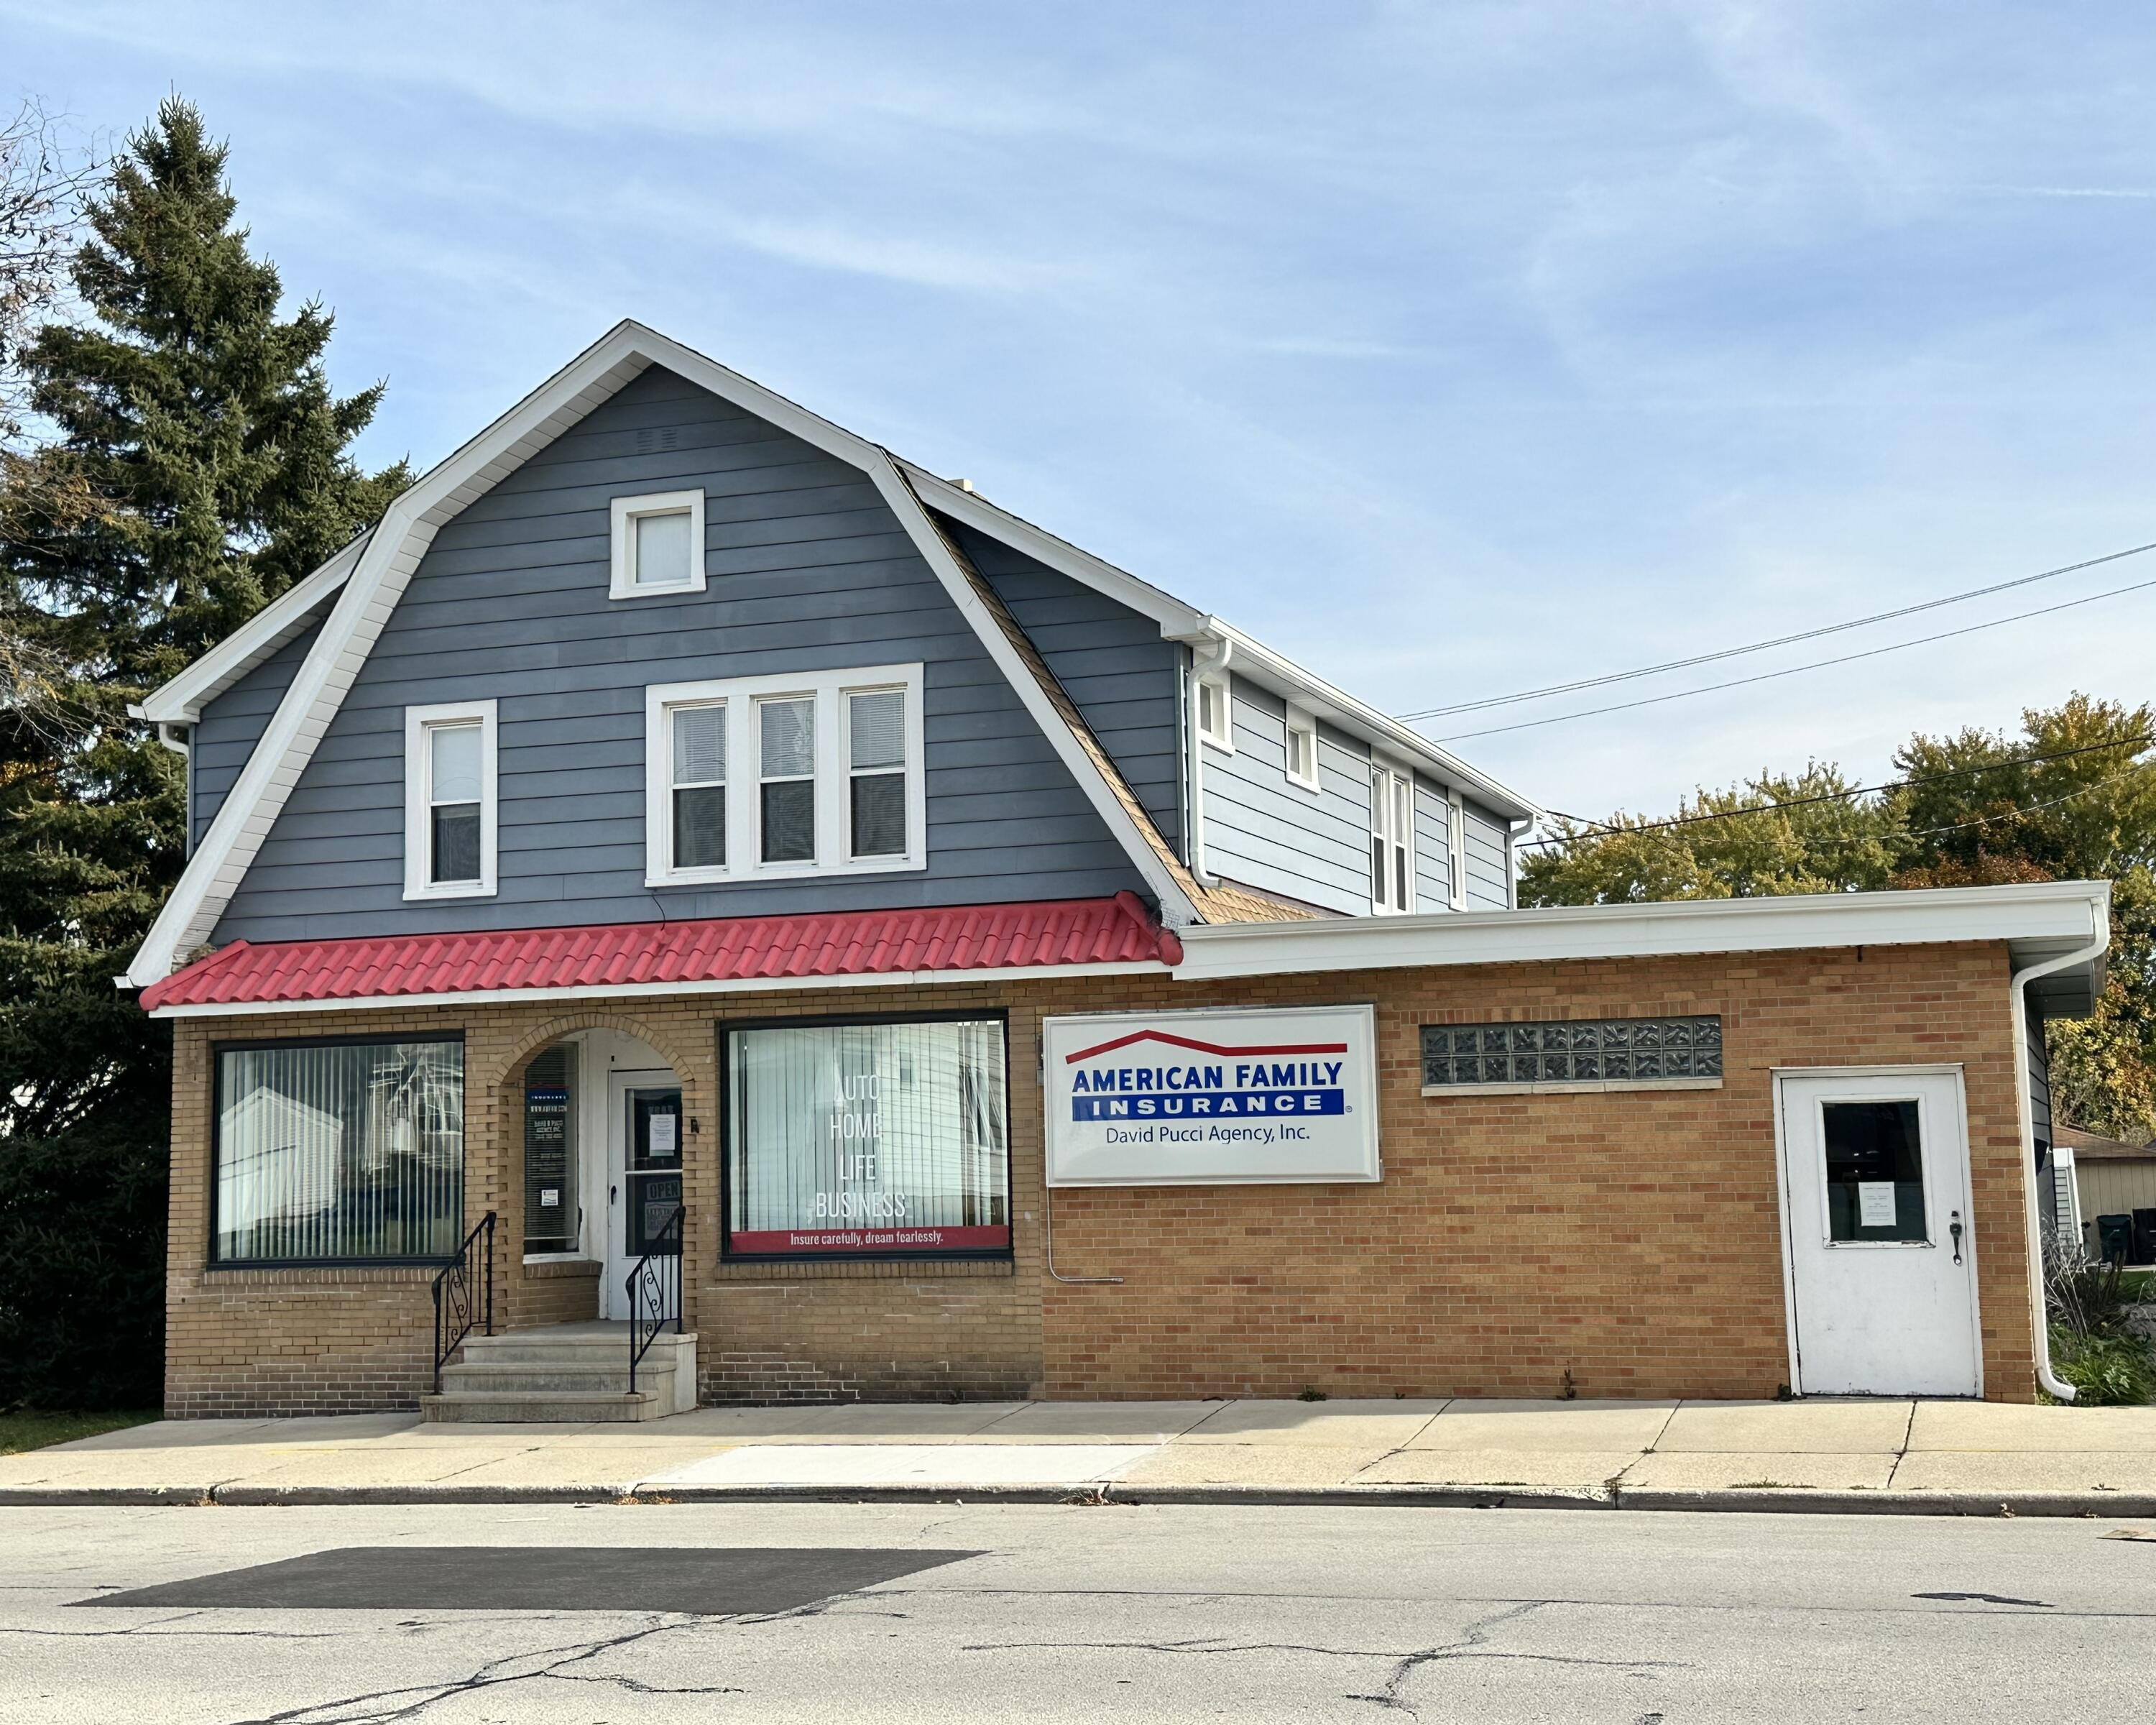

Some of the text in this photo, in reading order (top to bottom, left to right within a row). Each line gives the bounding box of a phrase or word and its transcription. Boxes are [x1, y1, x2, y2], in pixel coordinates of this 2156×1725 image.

[1072, 1062, 1342, 1092] AMERICAN FAMILY
[1092, 1094, 1322, 1116] INSURANCE
[830, 1113, 882, 1140] HOME
[1107, 1123, 1311, 1145] David Pucci Agency, Inc.
[839, 1154, 876, 1180] LIFE
[650, 1182, 678, 1199] OPEN
[816, 1191, 906, 1218] BUSINESS
[791, 1230, 944, 1247] Insure carefully, dream fearlessly.
